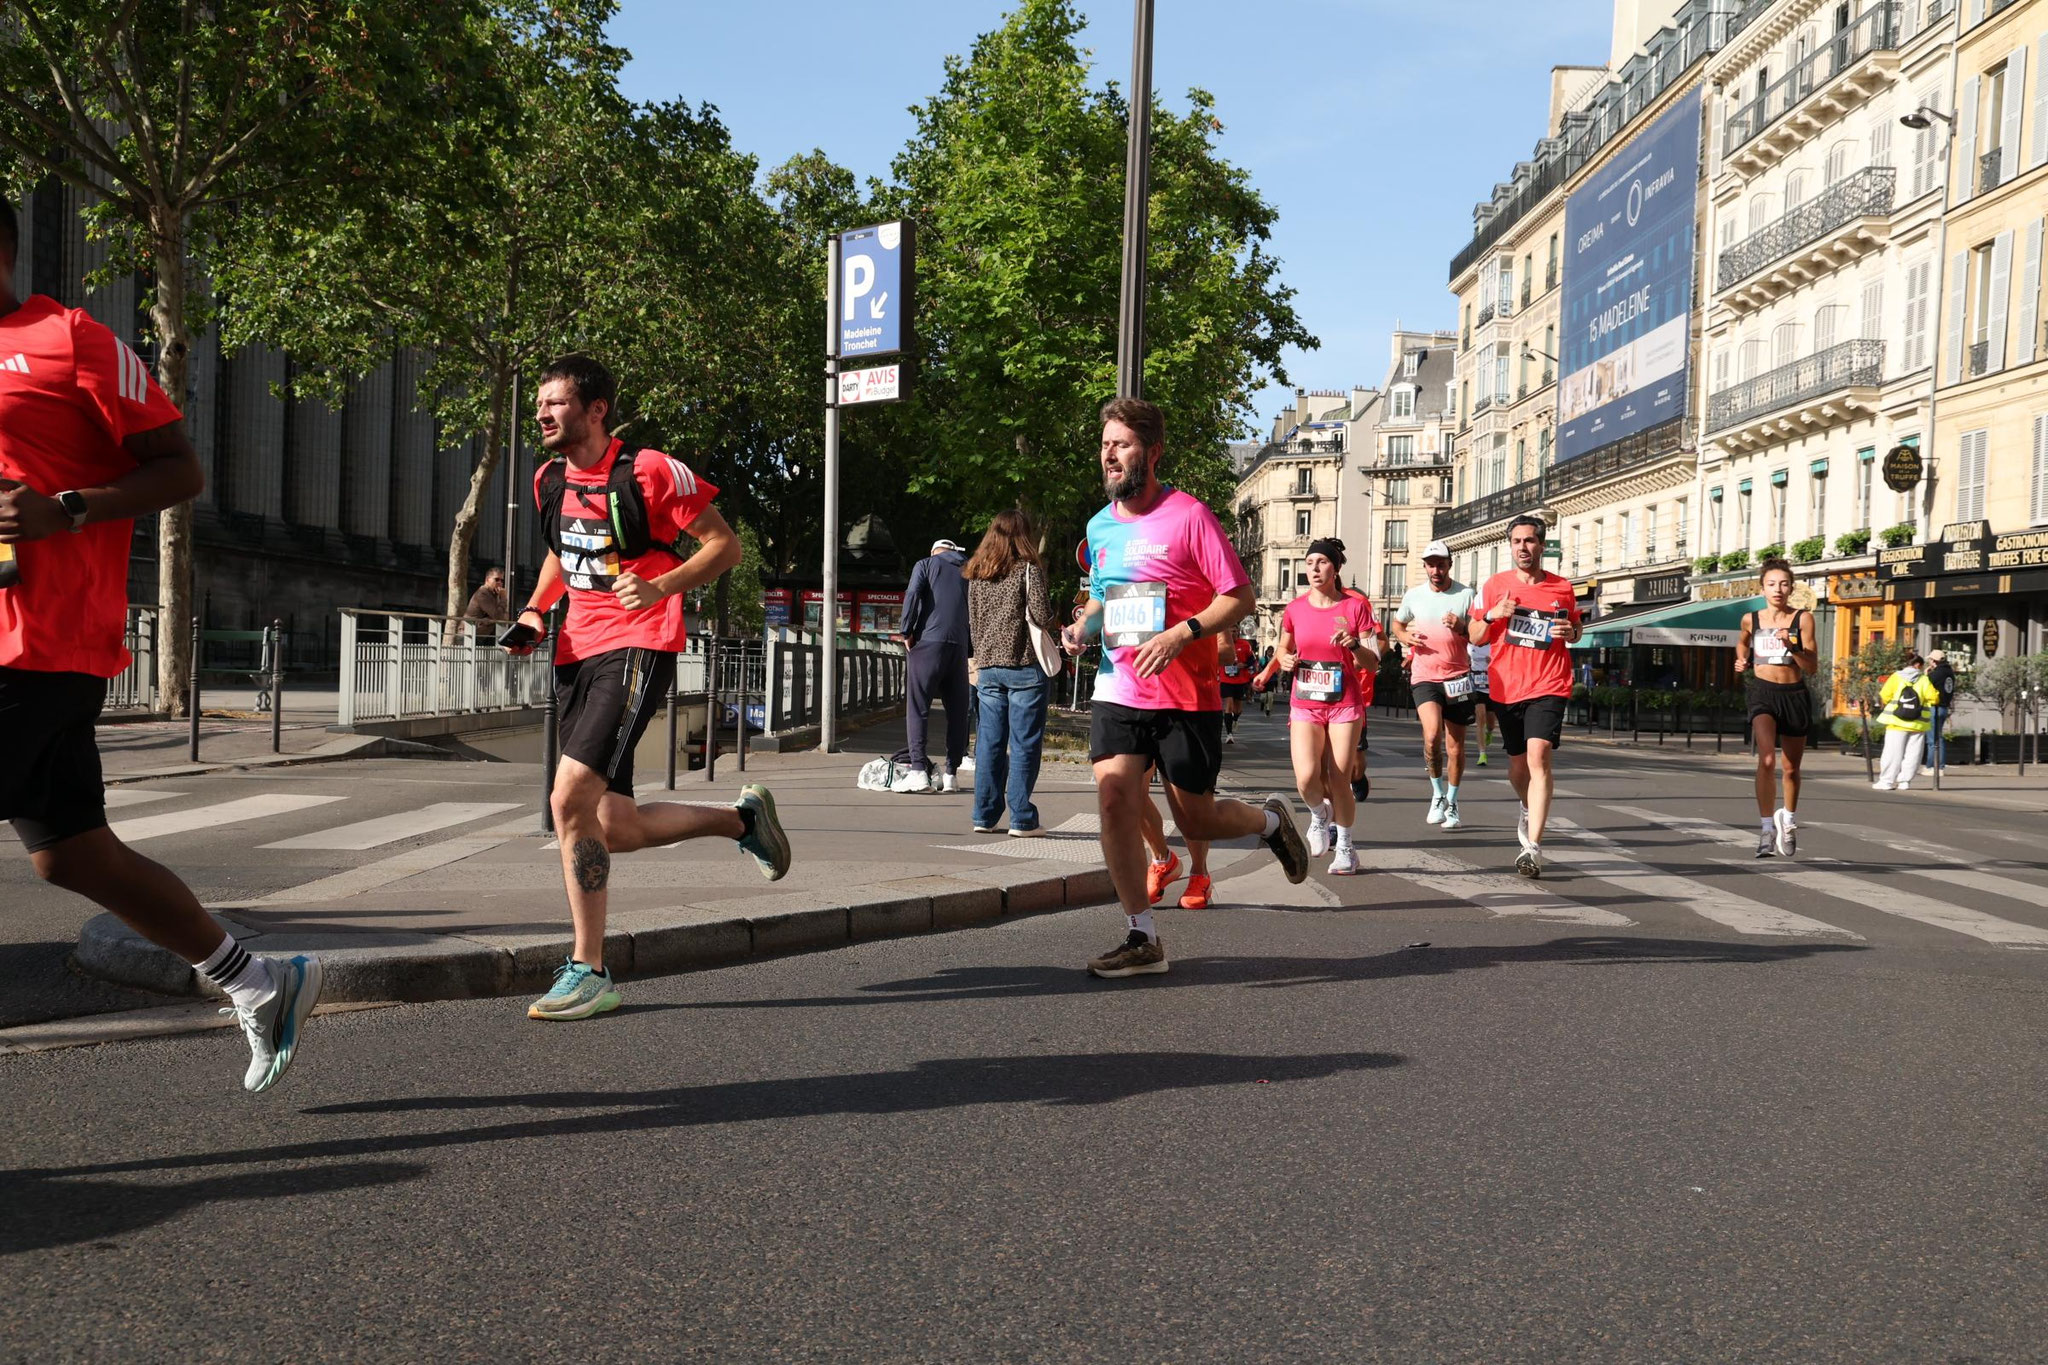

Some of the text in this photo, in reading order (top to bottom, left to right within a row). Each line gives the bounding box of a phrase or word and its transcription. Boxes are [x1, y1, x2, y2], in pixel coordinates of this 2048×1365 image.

[1645, 167, 1675, 202] INFRAVIA
[844, 254, 875, 321] P
[1589, 284, 1651, 343] 15 MADELEINE
[844, 326, 882, 340] Madeleine
[844, 338, 877, 351] Tronchet
[867, 368, 895, 386] AVIS
[842, 382, 859, 392] DARTY
[873, 385, 896, 397] Budget
[1890, 473, 1919, 481] TRUFFE
[1123, 544, 1169, 557] SOLIDAIRE
[1988, 551, 2020, 567] TRUFFES
[2022, 549, 2041, 564] FOIE
[1891, 562, 1910, 575] CAVE
[1109, 603, 1146, 627] 16146
[1512, 618, 1545, 637] 17262
[1690, 633, 1727, 643] KASPIA
[1302, 670, 1330, 686] 18900
[725, 710, 735, 722] P
